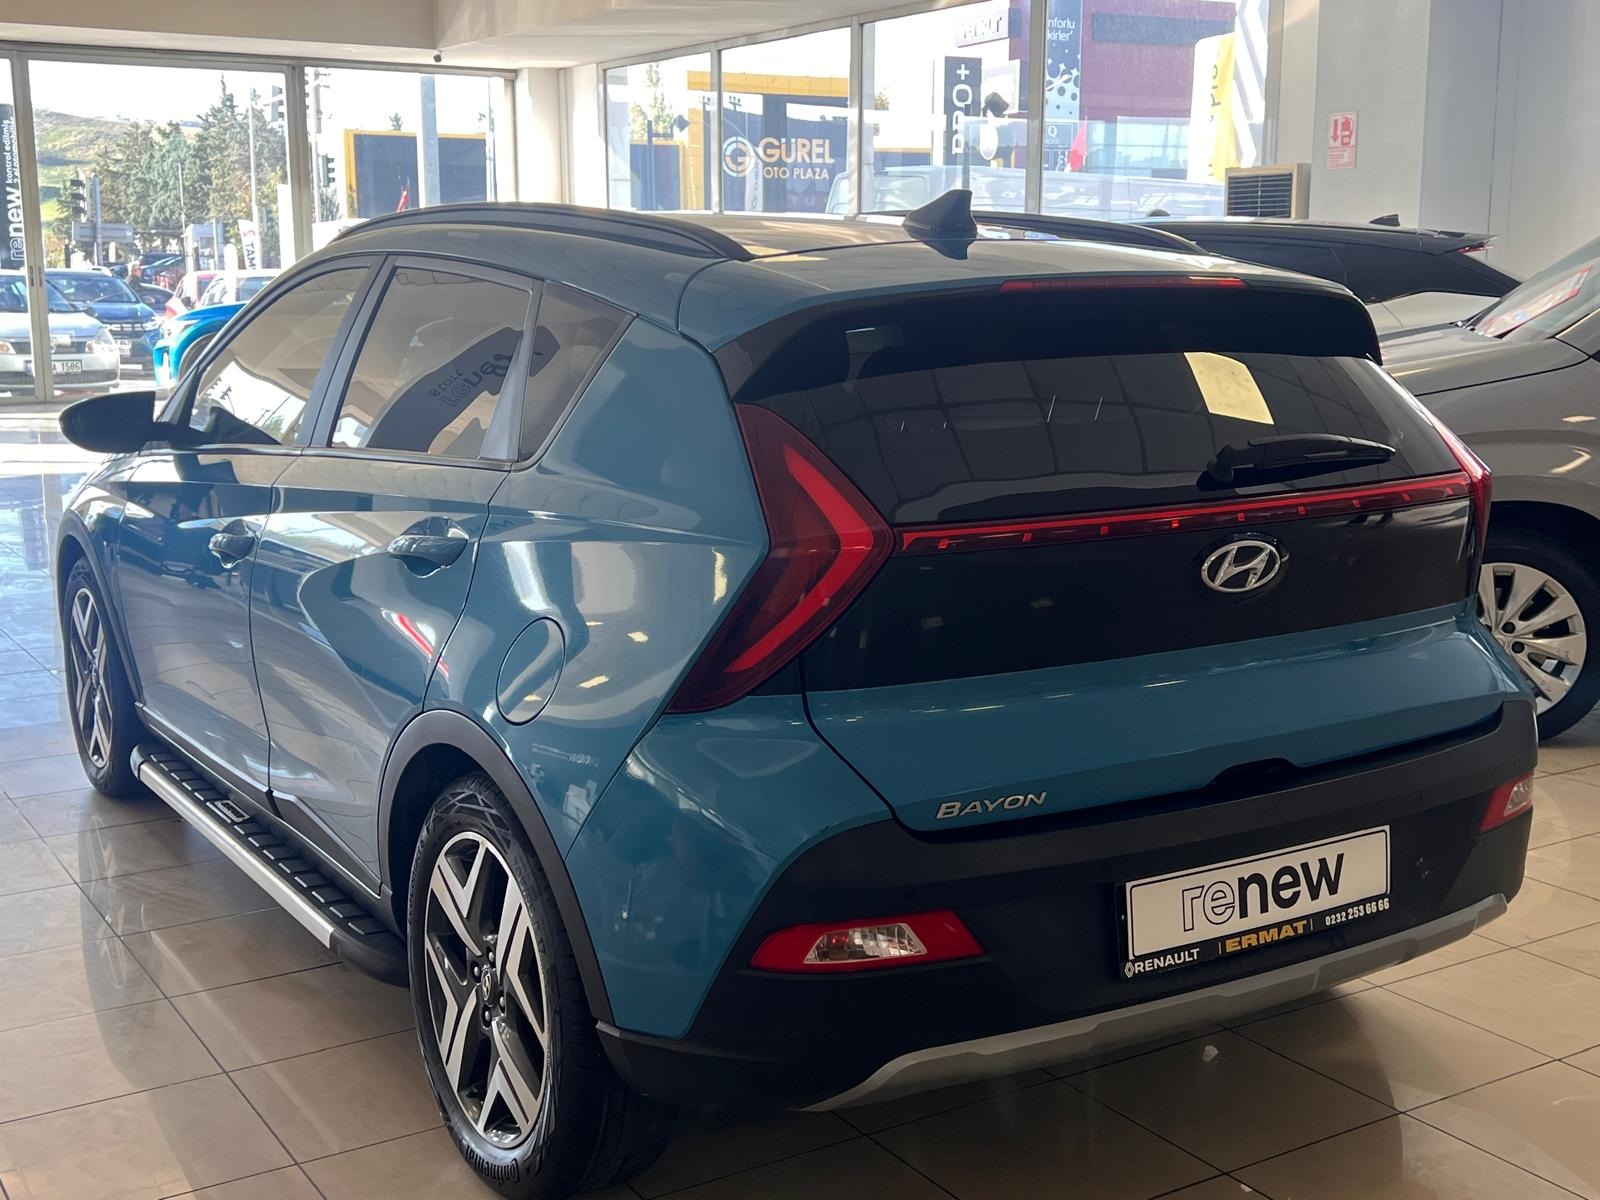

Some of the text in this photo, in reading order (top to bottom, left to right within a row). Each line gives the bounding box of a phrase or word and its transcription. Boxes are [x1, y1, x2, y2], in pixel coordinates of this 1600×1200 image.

[758, 137, 835, 163] GÜREL
[3, 152, 13, 184] kontrol
[763, 166, 829, 180] OTO PLAZA
[5, 186, 25, 261] renew
[243, 242, 257, 271] TAM
[936, 791, 1047, 819] BAYON
[1181, 852, 1344, 932] renew
[1134, 898, 1390, 974] RENAULT ERMAT 0232 253 66 66
[465, 1144, 520, 1185] Continental
